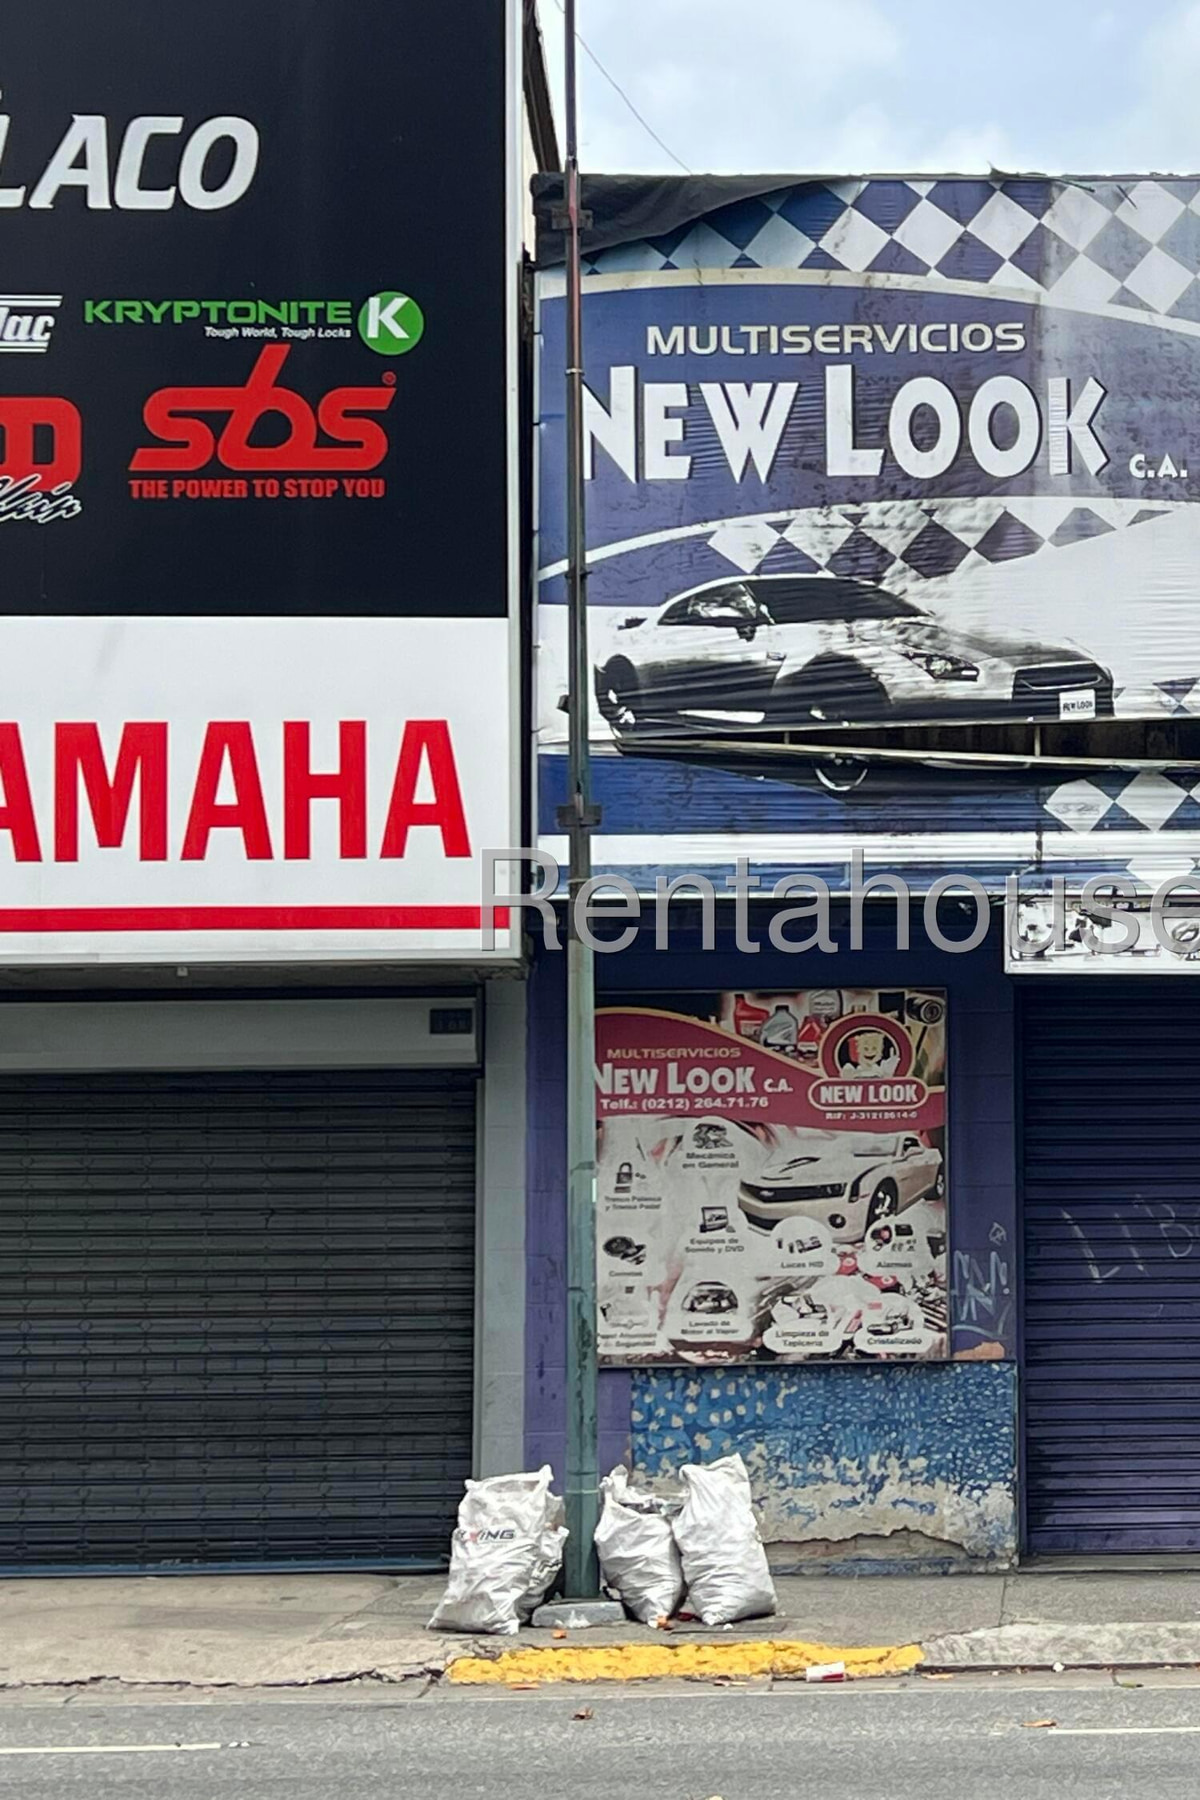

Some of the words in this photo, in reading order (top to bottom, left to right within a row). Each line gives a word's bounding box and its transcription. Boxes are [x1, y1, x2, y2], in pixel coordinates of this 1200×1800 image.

[84, 300, 353, 325] KRYPTONITE
[205, 326, 239, 339] Tough
[241, 327, 278, 338] World,
[281, 326, 315, 339] Tough
[317, 327, 351, 338] Locks
[646, 322, 1026, 355] MULTISERVICIOS
[582, 365, 800, 484] NEW
[825, 364, 1109, 480] LOOK
[1129, 453, 1190, 479] C.A.
[129, 479, 168, 498] THE
[173, 479, 247, 498] POWER
[253, 479, 279, 498] TO
[284, 479, 338, 498] STOP
[343, 479, 385, 498] YOU
[606, 1047, 742, 1059] MULTISERVICIOS
[594, 1063, 659, 1095] NEW
[667, 1062, 756, 1094] LOOK
[763, 1078, 794, 1093] C.A.
[641, 1098, 691, 1111] (0212)
[694, 1096, 769, 1109] 264.71.76
[820, 1085, 863, 1104] NEW
[868, 1084, 918, 1103] LOOK
[698, 1160, 739, 1169] General
